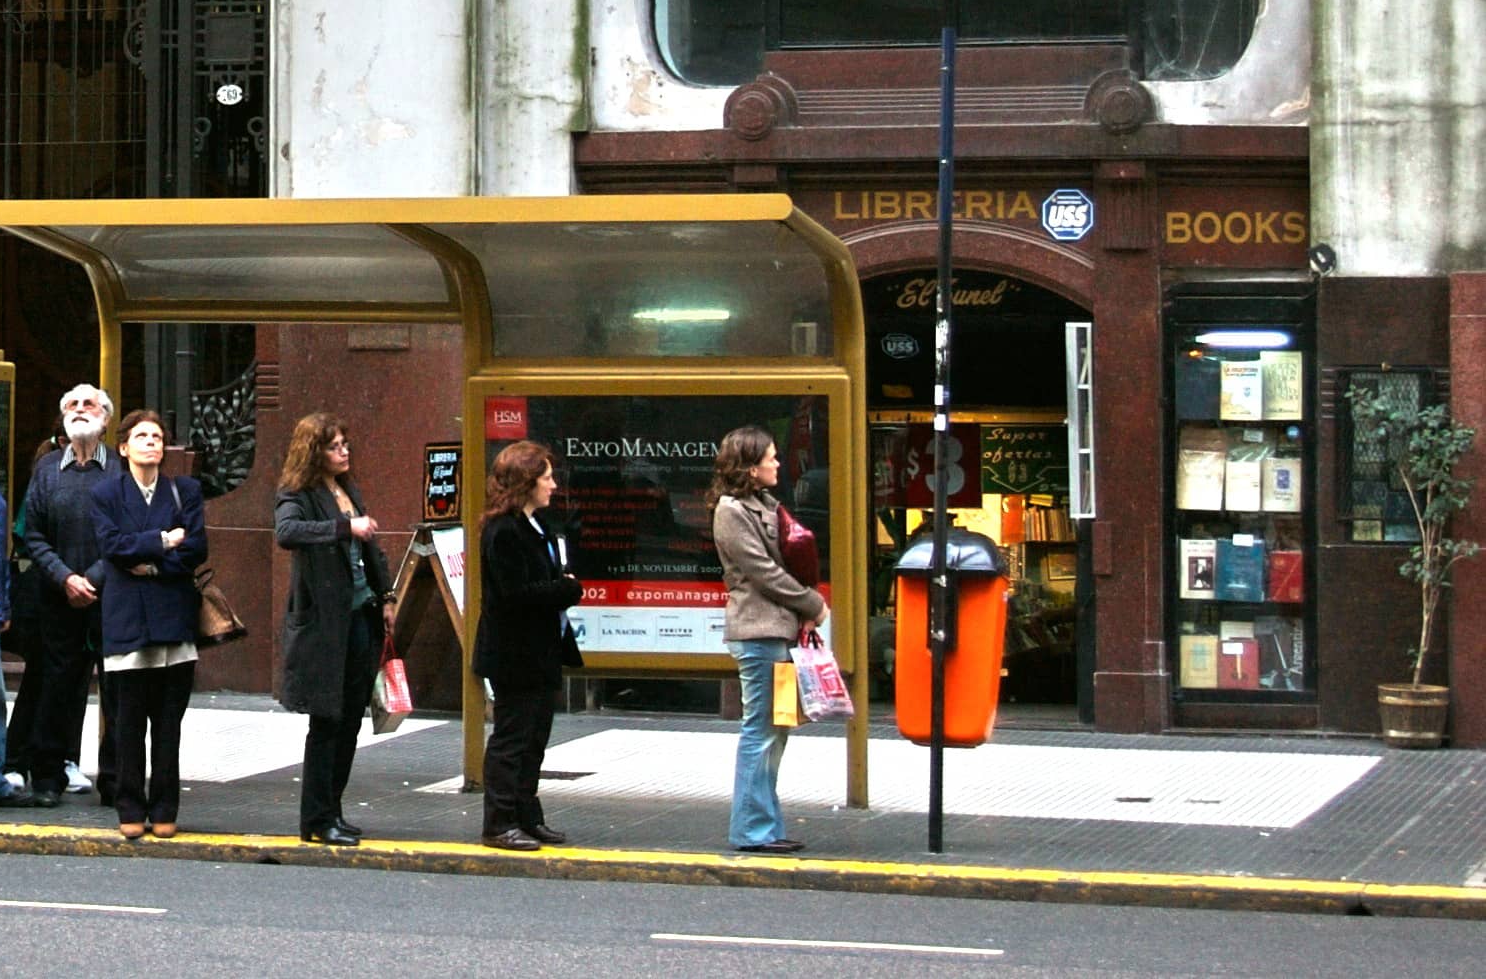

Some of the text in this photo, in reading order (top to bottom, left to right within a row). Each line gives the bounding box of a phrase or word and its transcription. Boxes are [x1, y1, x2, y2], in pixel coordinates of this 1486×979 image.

[1049, 204, 1088, 227] USS
[1166, 211, 1306, 244] BOOKS
[886, 342, 914, 352] USS
[494, 411, 522, 422] HSM
[986, 428, 1047, 444] Super
[982, 449, 1055, 464] ofertas
[627, 565, 640, 573] DE
[643, 564, 698, 573] NOVIEMBRE
